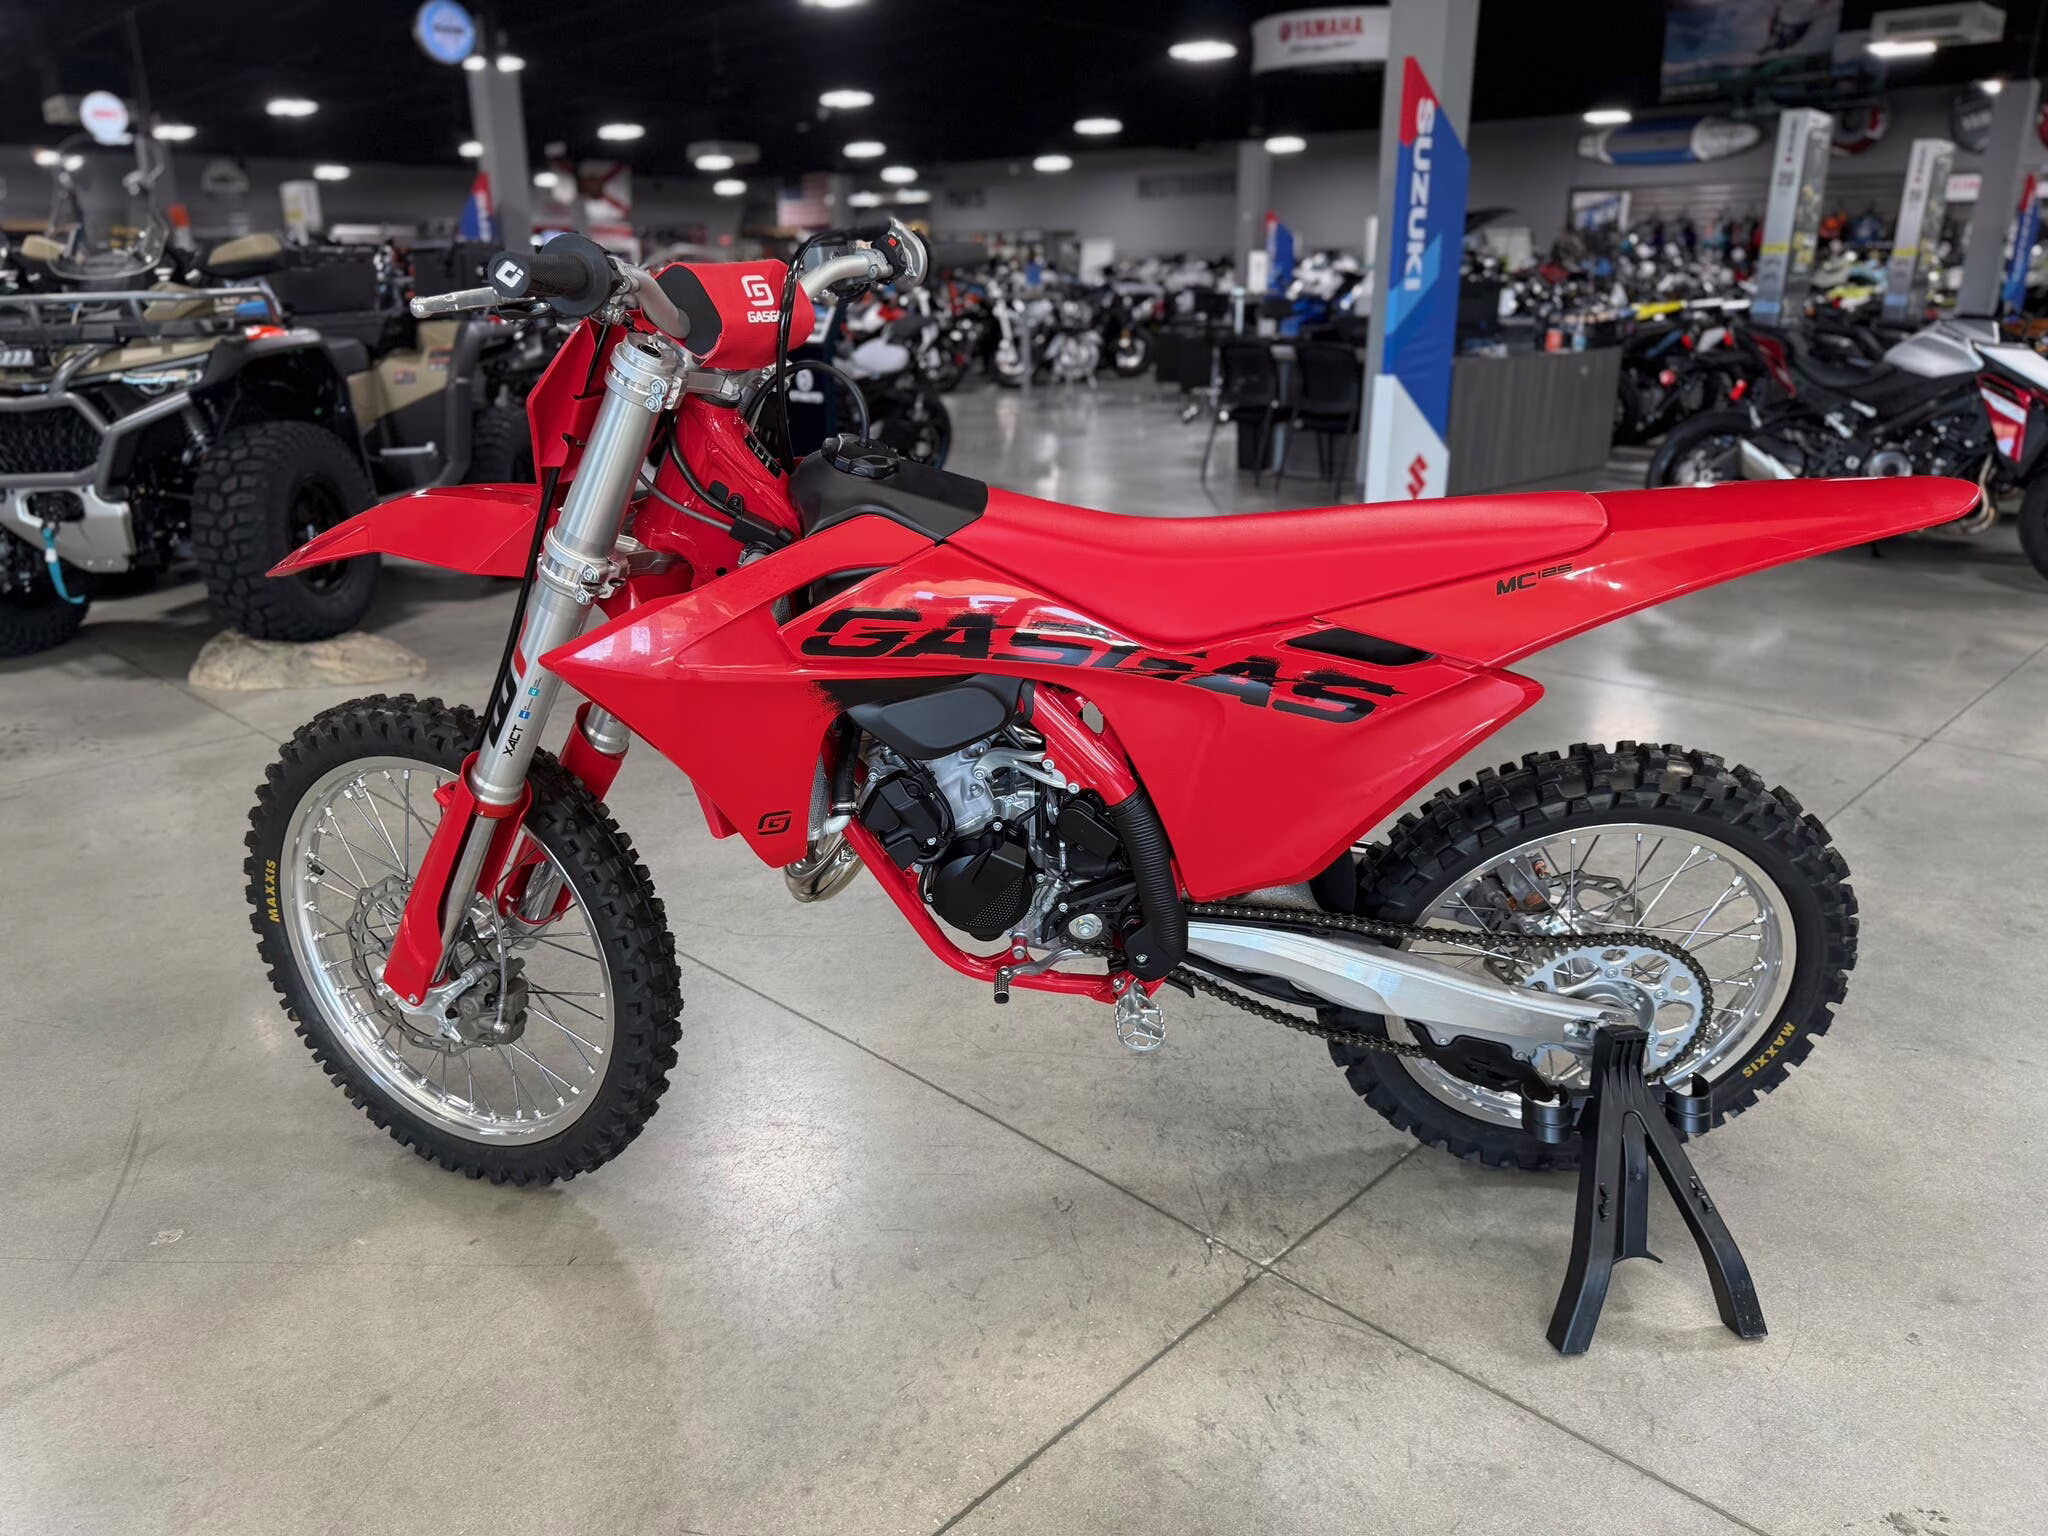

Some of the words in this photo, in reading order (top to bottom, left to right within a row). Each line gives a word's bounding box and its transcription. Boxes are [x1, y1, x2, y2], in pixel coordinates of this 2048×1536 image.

[1295, 14, 1364, 38] YAMAHA
[1404, 96, 1436, 292] SUZUKI
[801, 606, 1407, 724] GASGAS
[502, 724, 524, 757] XACT
[264, 859, 281, 923] MAXXIS
[1742, 1021, 1796, 1078] MAXXIS
